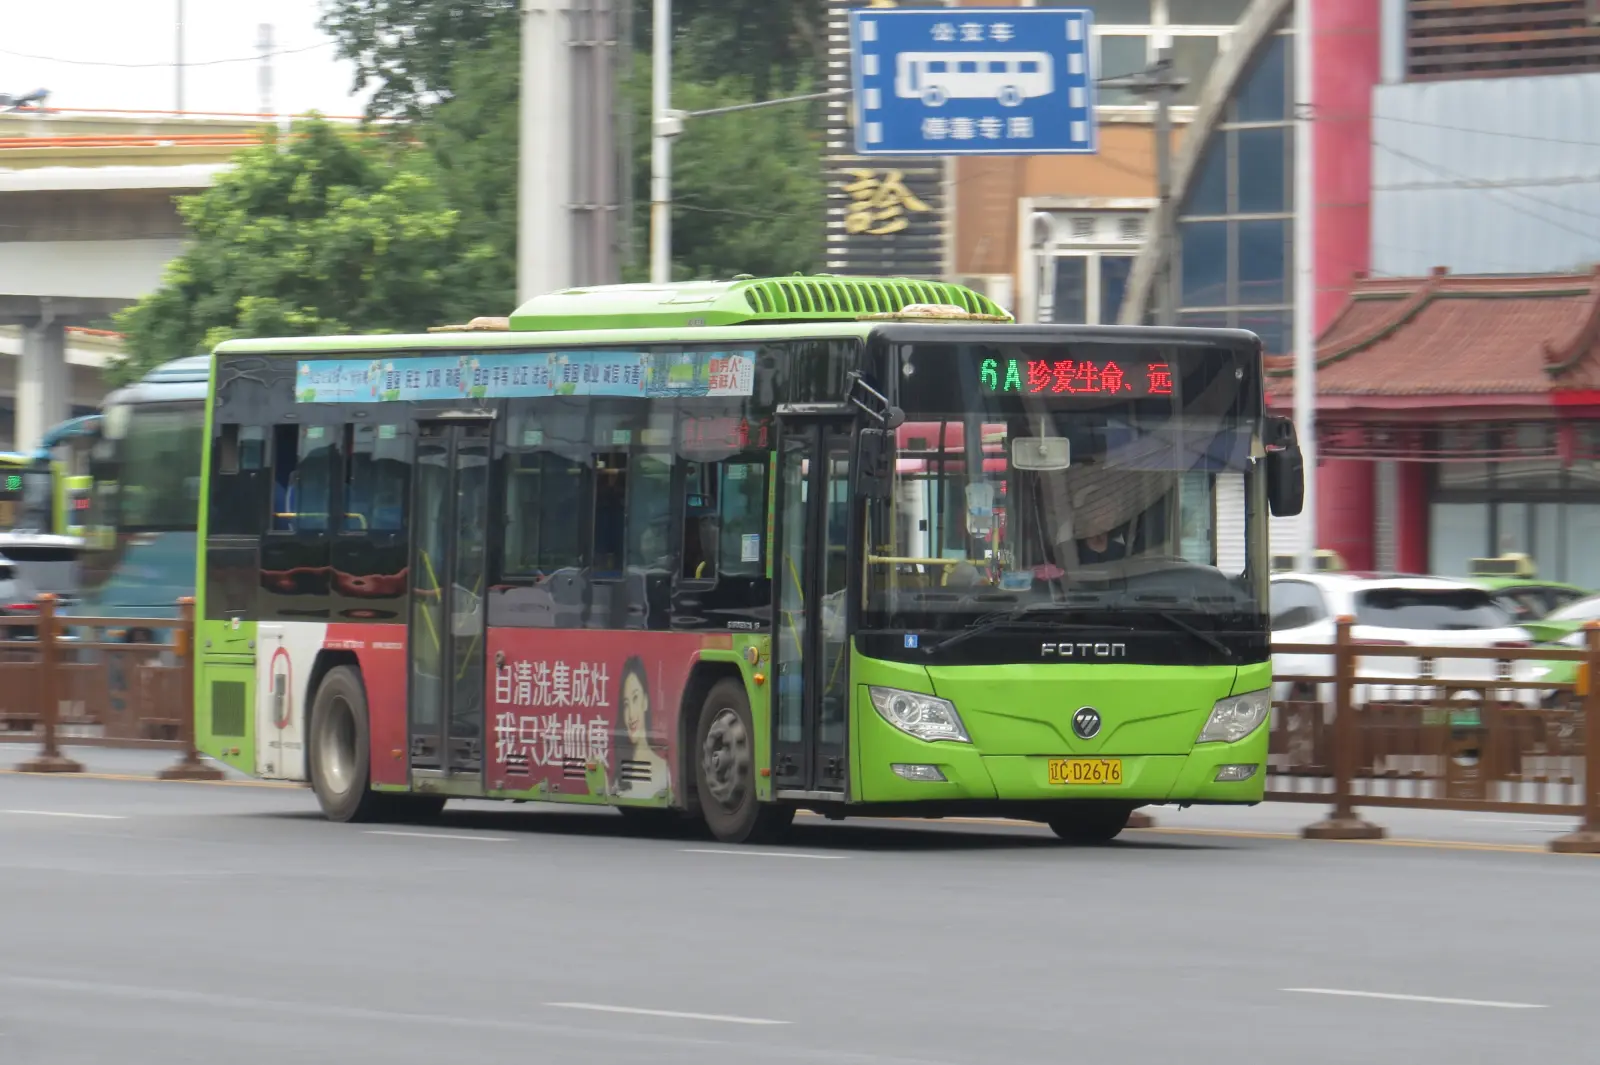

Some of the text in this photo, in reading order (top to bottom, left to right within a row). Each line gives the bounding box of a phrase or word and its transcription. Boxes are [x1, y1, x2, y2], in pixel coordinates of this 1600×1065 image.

[930, 23, 1016, 42] 公交车
[1041, 643, 1126, 656] FOTON
[495, 660, 610, 707] 自清洗集成灶
